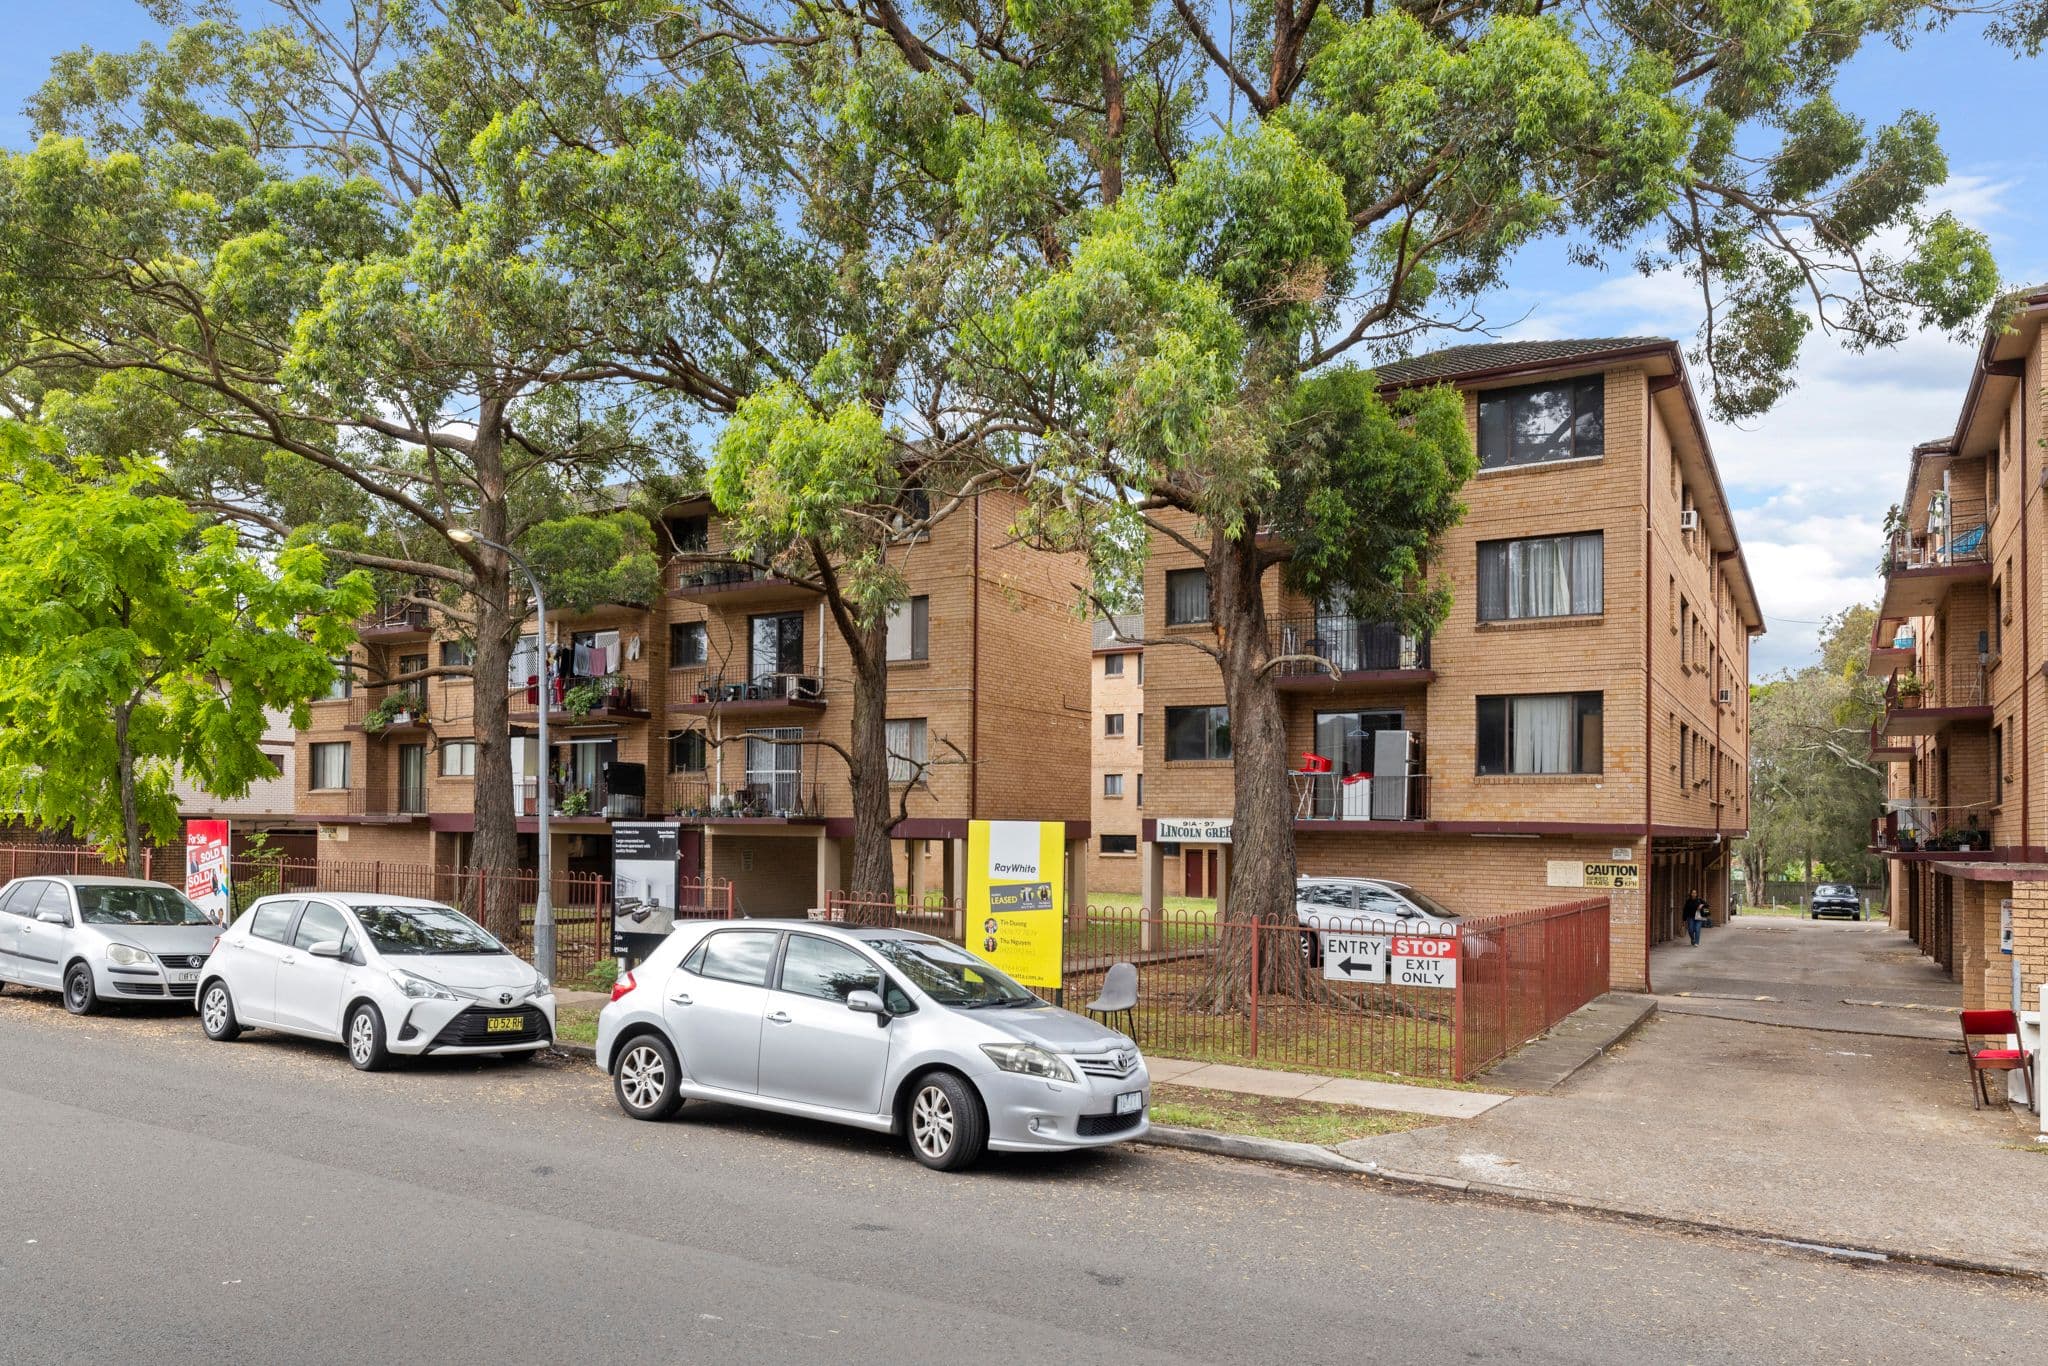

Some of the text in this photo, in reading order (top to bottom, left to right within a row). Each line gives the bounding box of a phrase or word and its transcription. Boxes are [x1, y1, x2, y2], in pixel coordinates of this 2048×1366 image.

[1160, 822, 1233, 838] LINCOLN GREE
[196, 834, 207, 844] Sale
[200, 848, 220, 864] SOLD
[994, 862, 1036, 874] RayWhite
[1585, 864, 1638, 876] CAUTION
[188, 870, 210, 888] SOLD
[1614, 877, 1624, 887] 5
[991, 896, 1018, 905] LEASED
[1328, 940, 1381, 956] ENTRY
[1396, 940, 1451, 956] STOP
[1406, 960, 1440, 970] EXIT
[1402, 972, 1444, 984] ONLY
